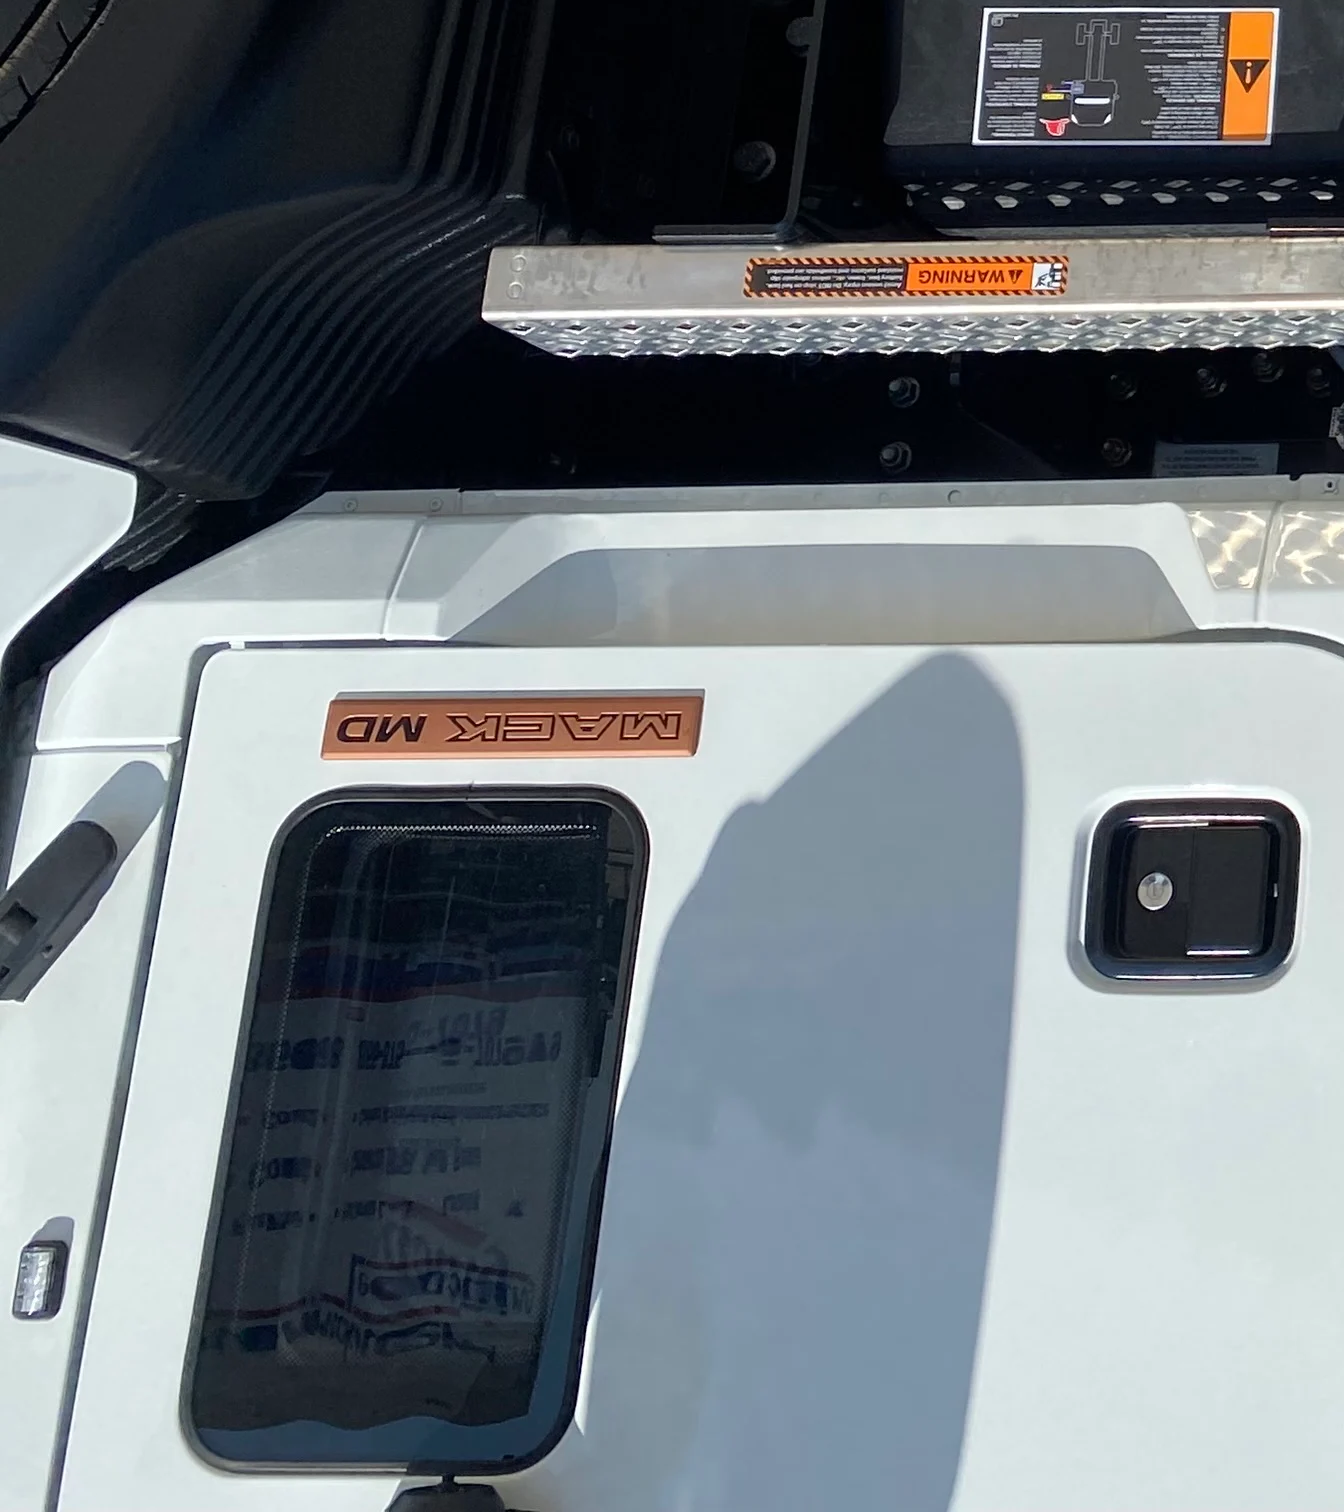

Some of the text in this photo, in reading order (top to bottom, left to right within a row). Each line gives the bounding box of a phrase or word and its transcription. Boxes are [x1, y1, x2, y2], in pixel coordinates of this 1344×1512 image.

[918, 270, 1005, 284] WARNING
[335, 712, 683, 744] MACK MD
